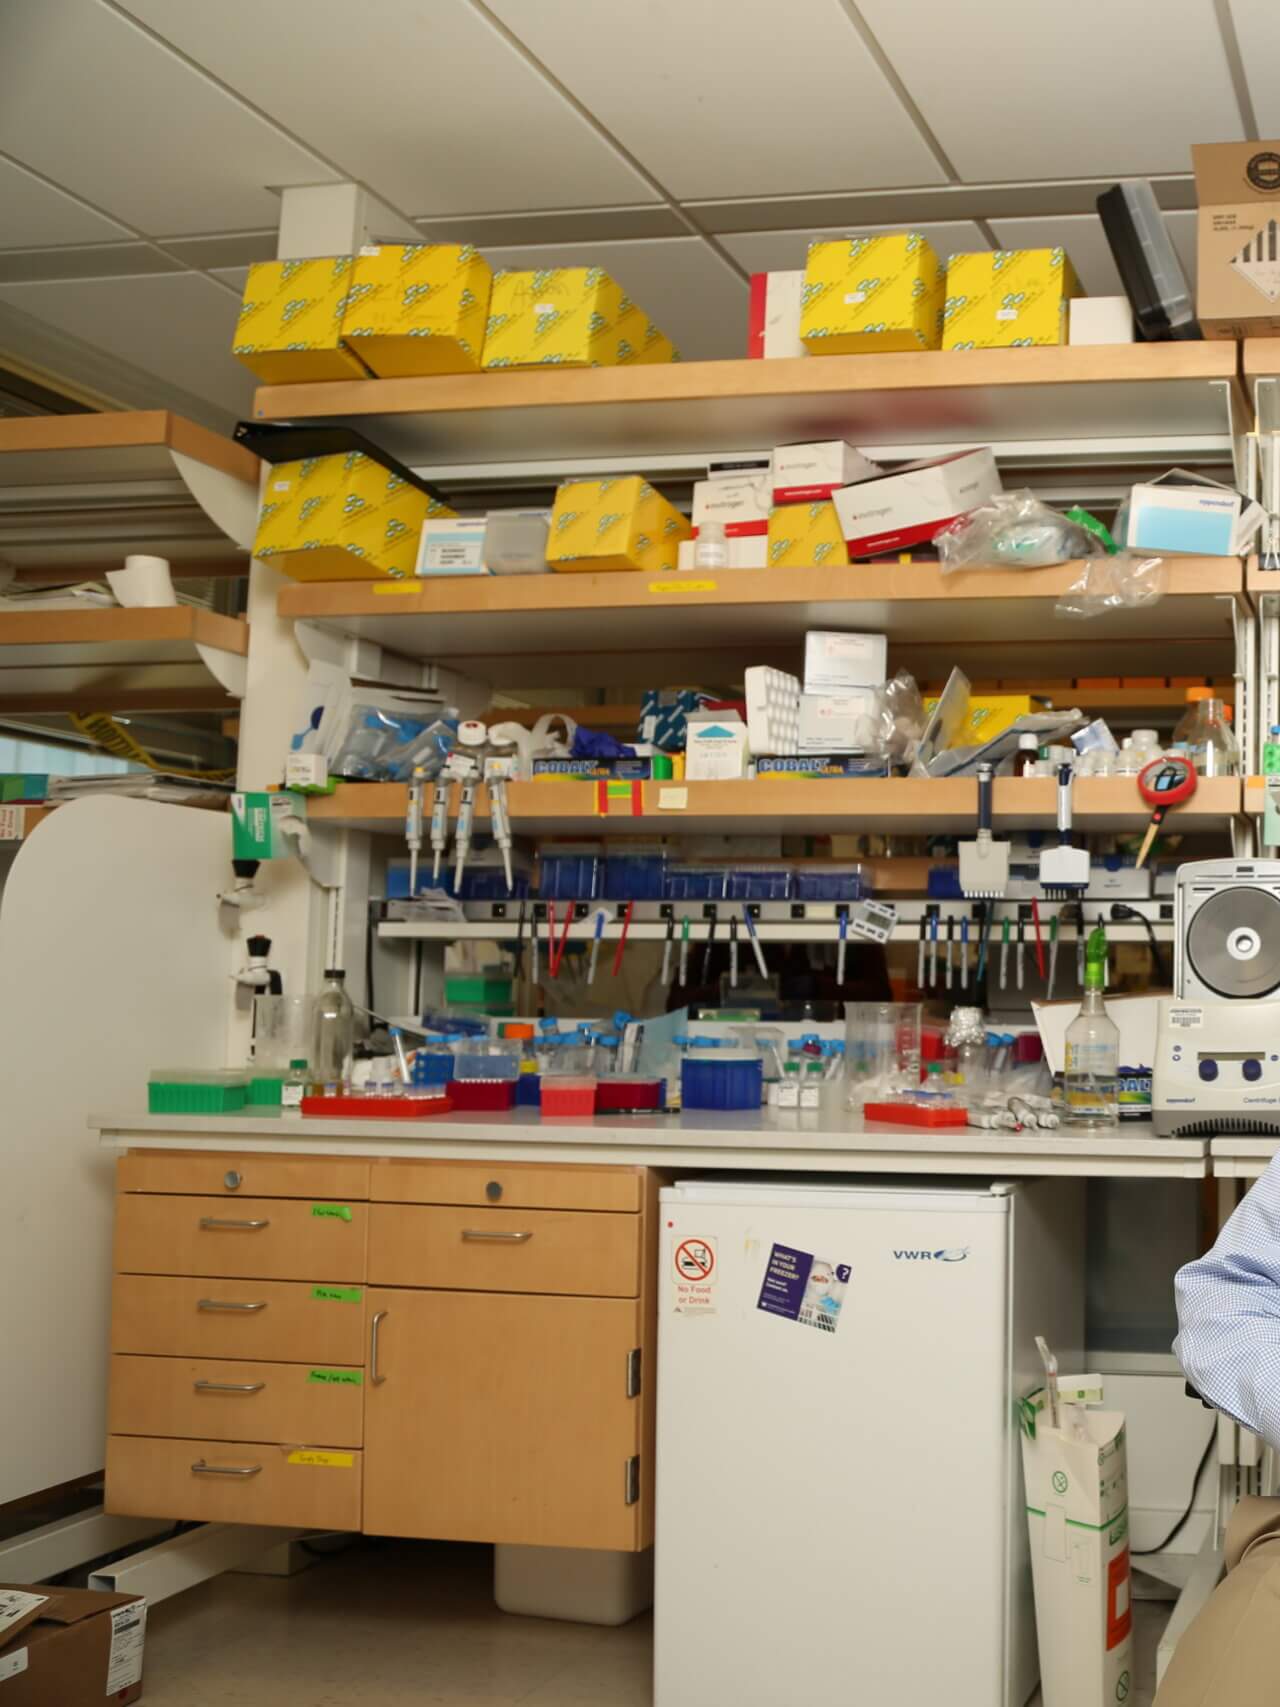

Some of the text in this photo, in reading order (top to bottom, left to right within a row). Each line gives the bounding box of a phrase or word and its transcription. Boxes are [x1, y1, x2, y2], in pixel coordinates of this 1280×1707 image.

[757, 758, 832, 772] COBALT
[1243, 1096, 1277, 1105] Centrifuge
[773, 1251, 797, 1264] WHAT'S
[893, 1250, 932, 1260] VWR
[779, 1261, 796, 1272] YOUR
[769, 1266, 800, 1280] FREEZER?
[841, 1267, 850, 1280] ?
[677, 1286, 712, 1294] No Food
[688, 1296, 710, 1305] Drink
